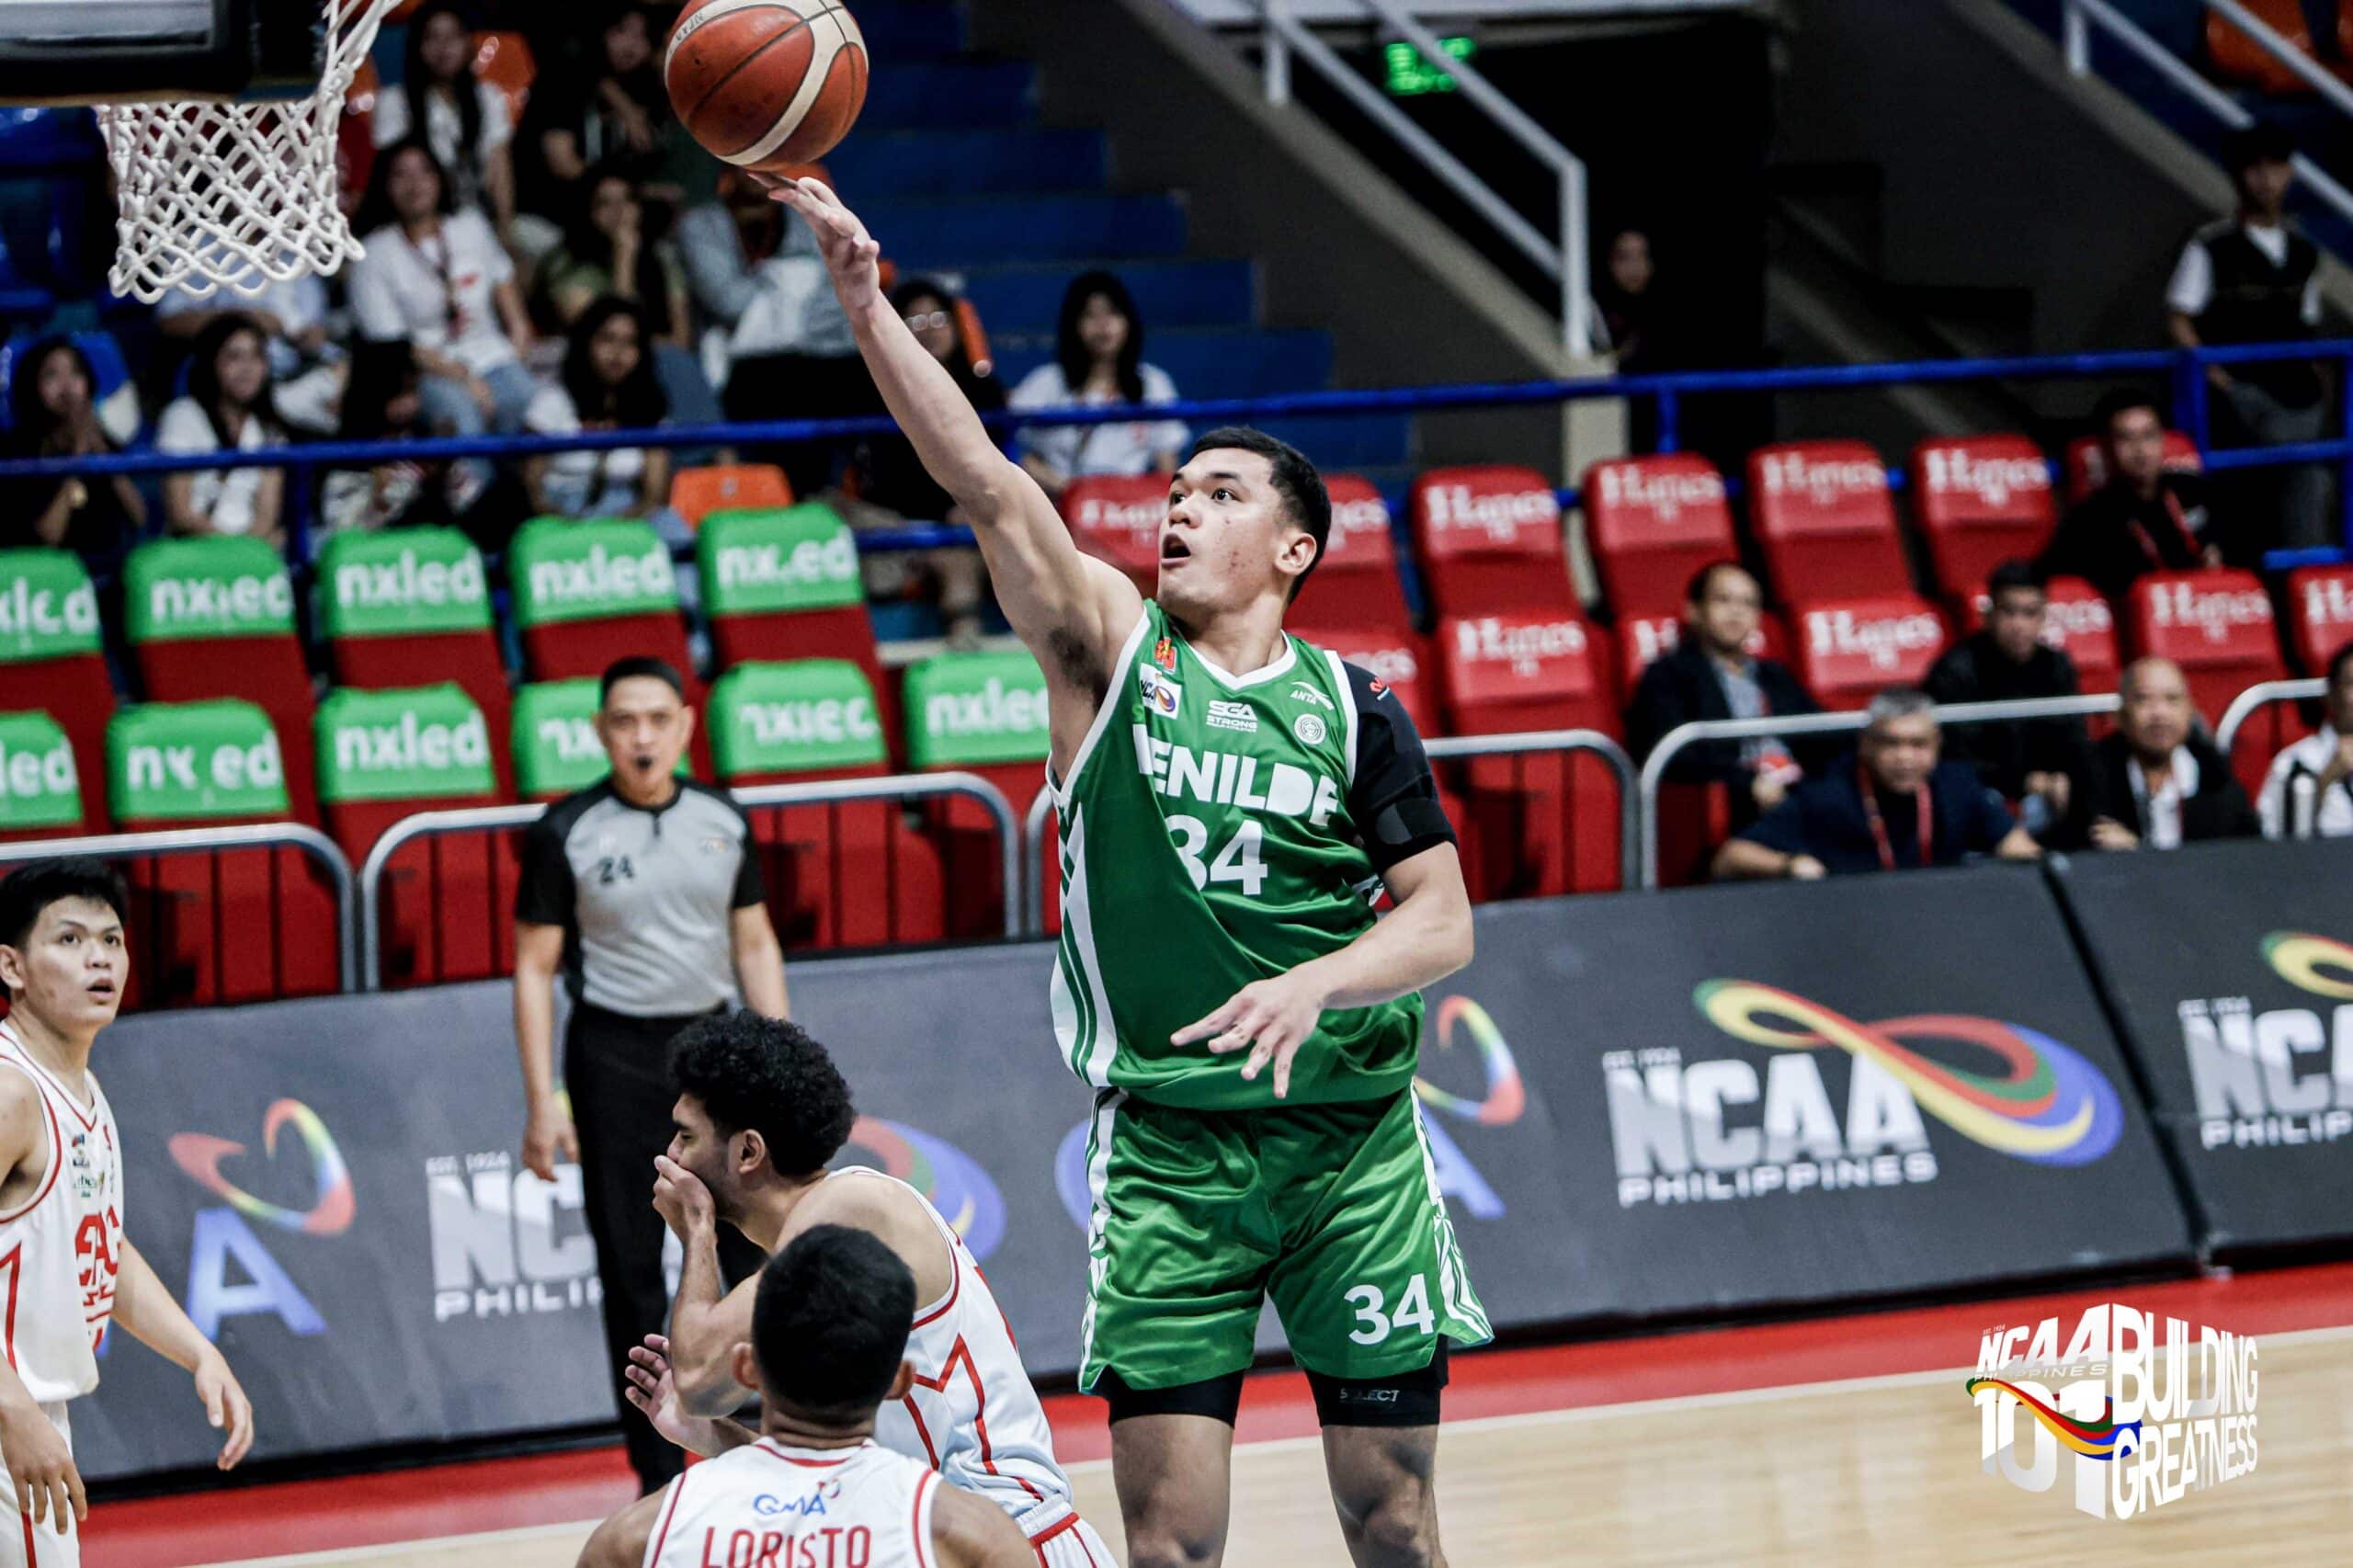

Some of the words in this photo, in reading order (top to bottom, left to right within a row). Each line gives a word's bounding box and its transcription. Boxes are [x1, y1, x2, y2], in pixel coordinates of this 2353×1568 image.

[336, 546, 485, 608] nxled
[529, 542, 676, 603] nxled
[716, 525, 858, 586] nxed
[1206, 715, 1257, 730] STRONG
[1290, 689, 1317, 705] ANTA
[335, 709, 490, 773] nxled
[598, 854, 635, 885] 24
[1164, 814, 1268, 896] 34
[1606, 1051, 1931, 1179] NCAA
[1618, 1152, 1938, 1208] PHILIPPINES
[427, 1163, 598, 1289] NC
[1344, 1273, 1435, 1345] 34
[1339, 1388, 1400, 1403] SLECT
[753, 1493, 826, 1516] GMA
[700, 1525, 871, 1568] LORISTO
